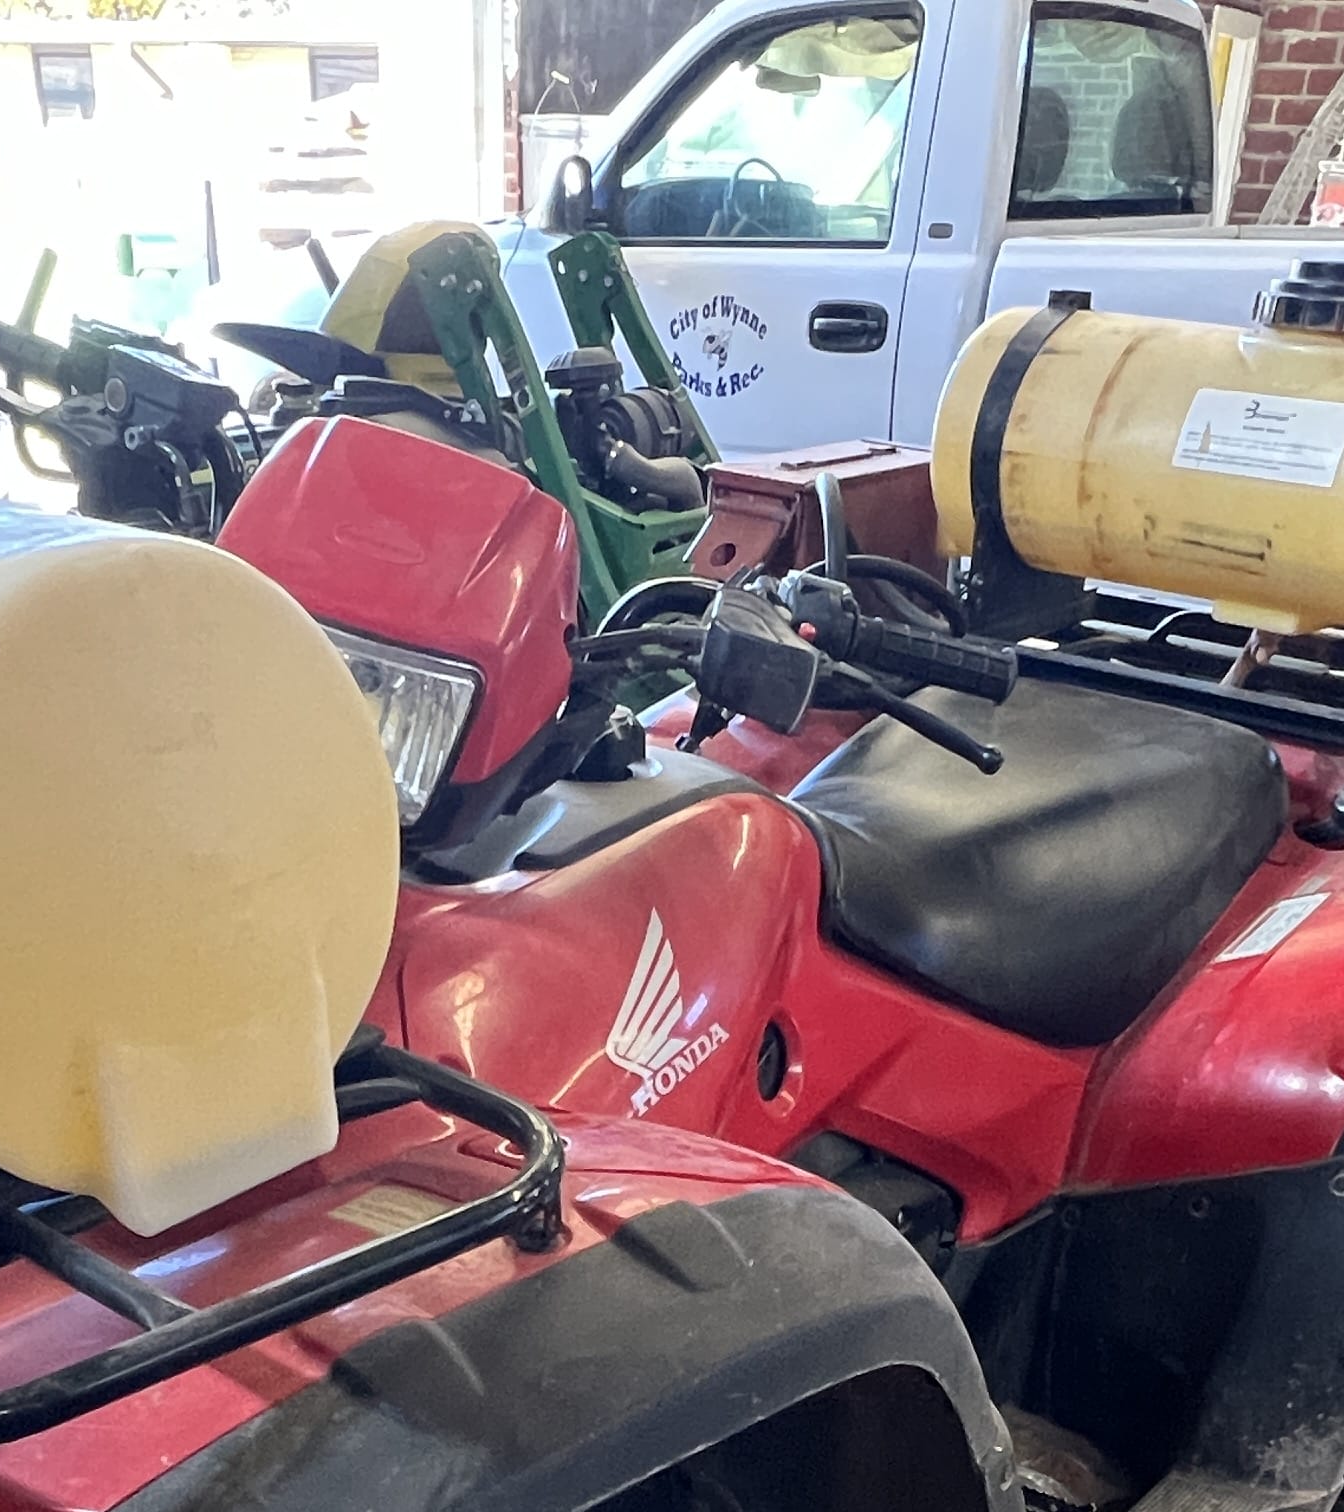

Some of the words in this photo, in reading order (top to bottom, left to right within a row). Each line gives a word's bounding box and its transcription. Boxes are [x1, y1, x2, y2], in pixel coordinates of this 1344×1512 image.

[669, 307, 699, 340] City
[702, 295, 719, 320] of
[720, 294, 768, 340] Wynne
[716, 376, 728, 398] &
[626, 1021, 730, 1119] HONDA
